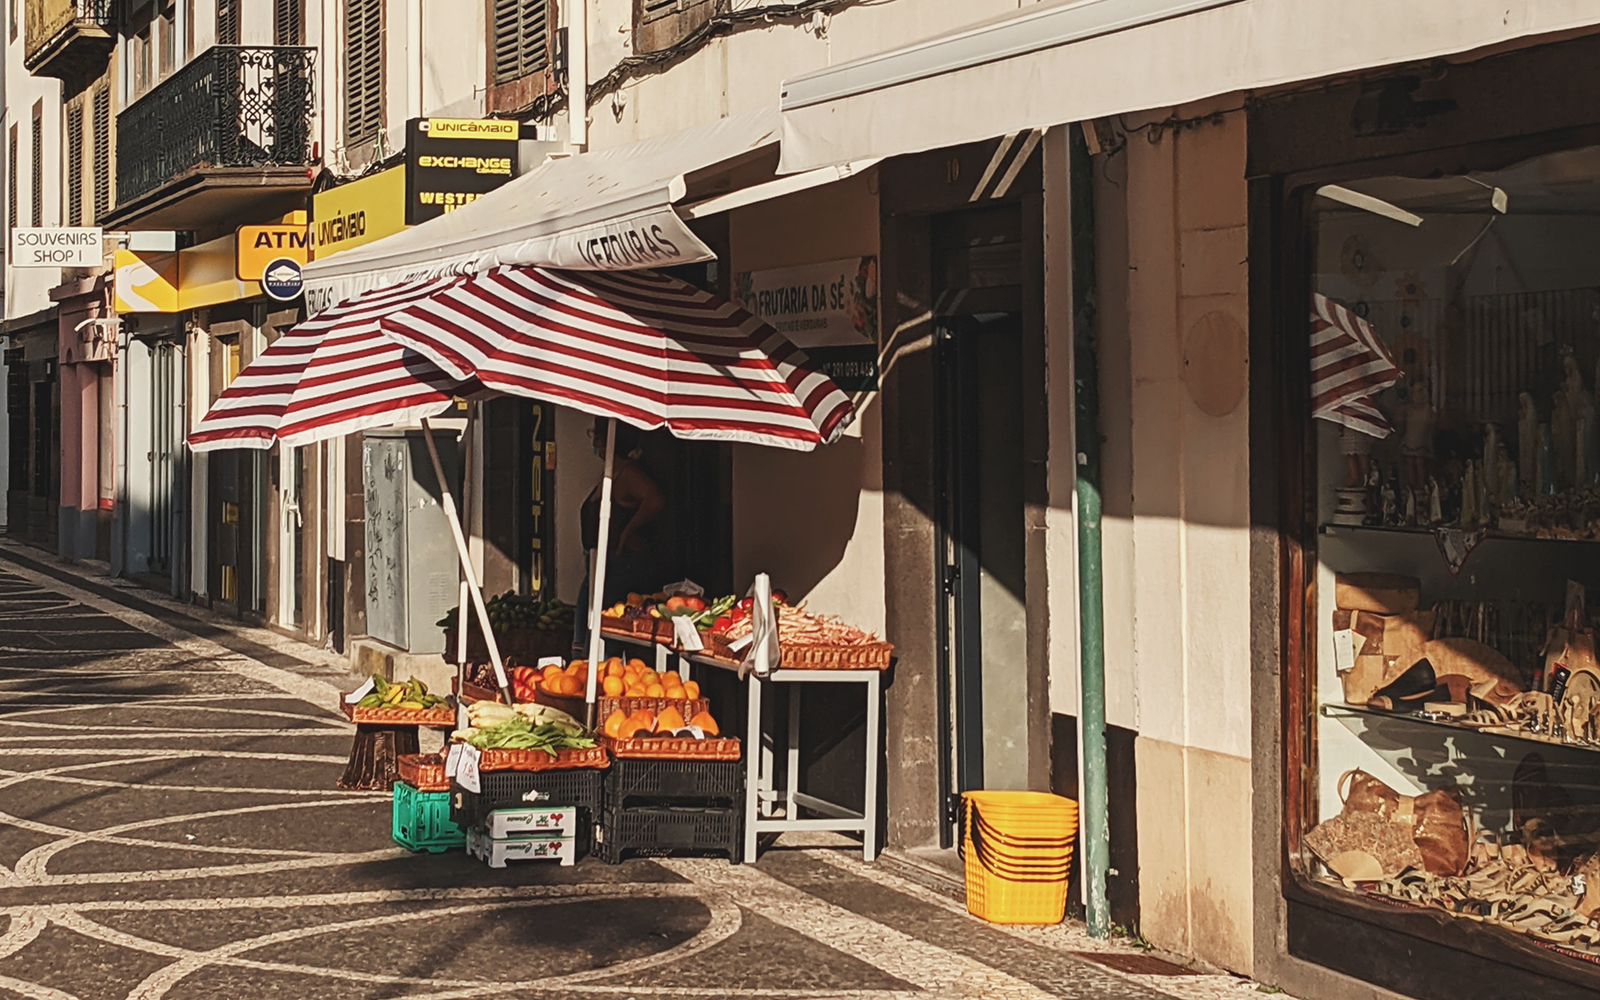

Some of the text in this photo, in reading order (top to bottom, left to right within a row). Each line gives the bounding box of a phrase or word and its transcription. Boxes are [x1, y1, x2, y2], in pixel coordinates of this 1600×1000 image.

[17, 232, 97, 246] SOUVENIRS
[253, 231, 307, 248] ATM
[577, 224, 681, 269] VERDURAS
[33, 249, 74, 262] SHOP
[758, 274, 845, 317] FRUTARIA DA SÉ
